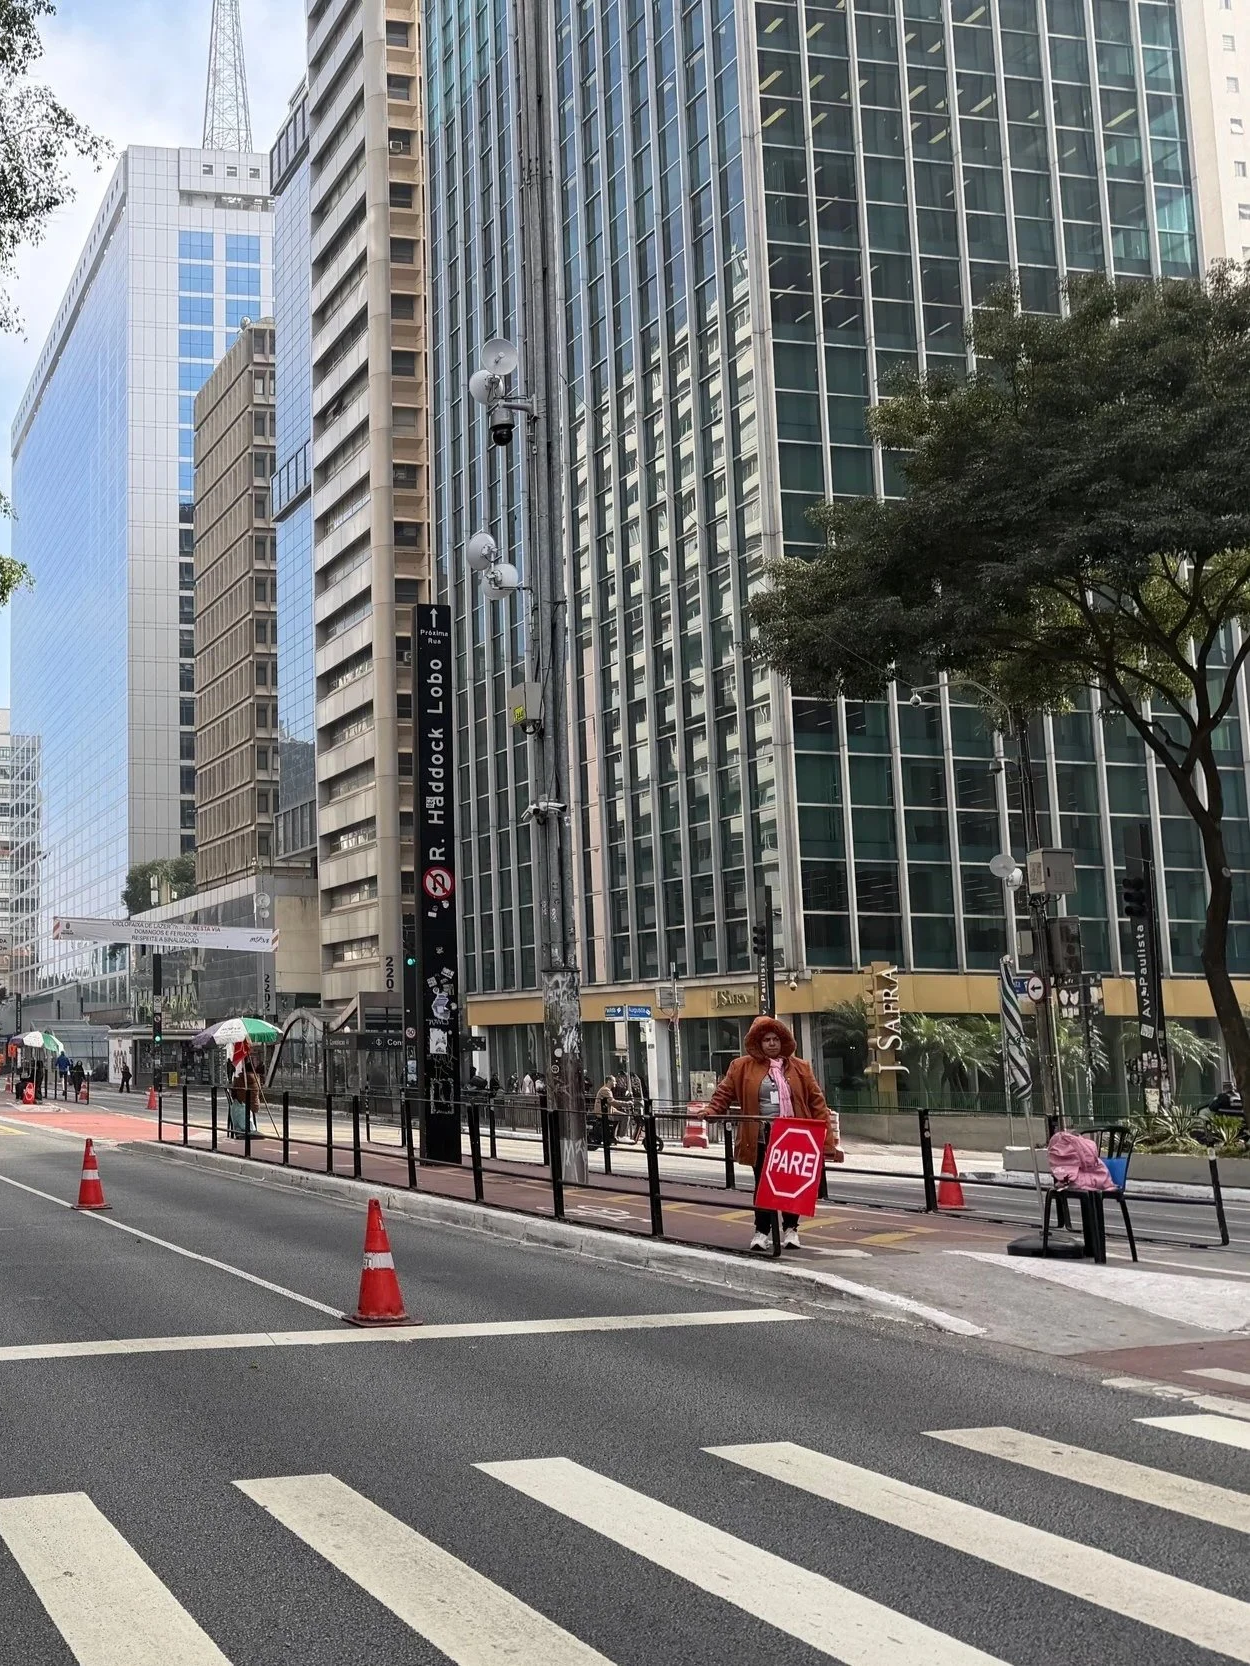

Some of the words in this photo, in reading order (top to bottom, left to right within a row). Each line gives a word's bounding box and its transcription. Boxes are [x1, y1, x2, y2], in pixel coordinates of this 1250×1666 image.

[420, 629, 448, 637] Próxima
[426, 659, 443, 714] Lobo
[427, 727, 445, 825] Haddock
[429, 838, 446, 861] R.
[112, 920, 144, 928] CICLOFAIXA
[134, 928, 164, 936] DOMINGOS
[163, 937, 199, 945] SINALIZAÇÃO
[1135, 924, 1148, 988] Paulista
[385, 956, 395, 992] 220
[875, 965, 903, 1050] SAFRA
[769, 1148, 816, 1178] PARE
